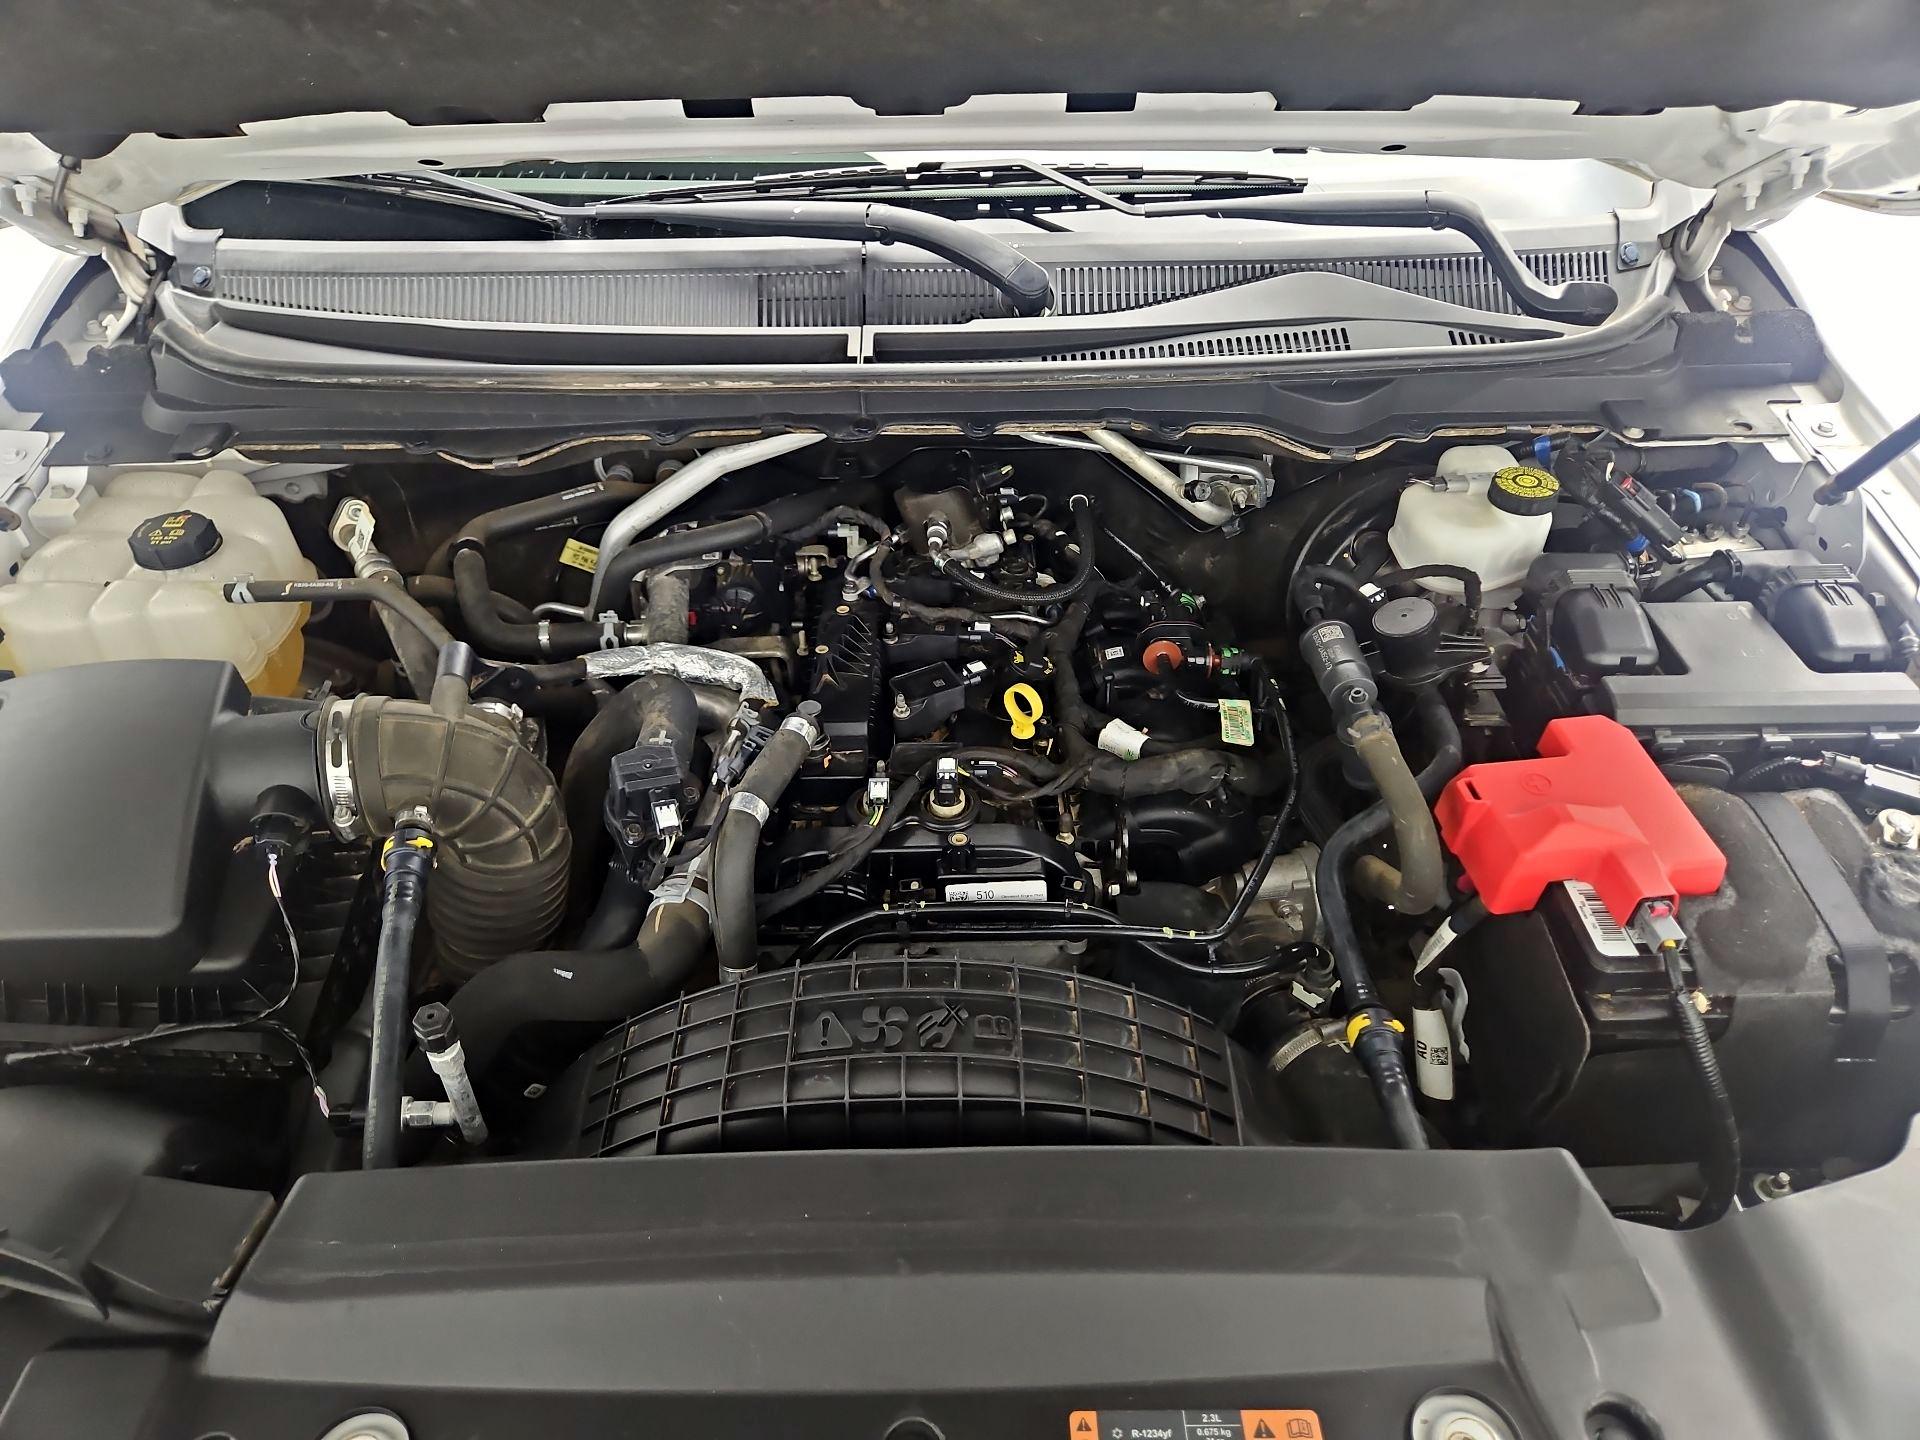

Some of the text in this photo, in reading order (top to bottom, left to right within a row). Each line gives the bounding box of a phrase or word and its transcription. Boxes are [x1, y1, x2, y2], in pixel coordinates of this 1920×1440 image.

[976, 890, 995, 900] 510
[1416, 1040, 1428, 1060] AD
[1201, 1413, 1223, 1423] 2.3L
[1131, 1428, 1172, 1439] R-1234yf
[1196, 1427, 1232, 1438] 0.675 kg
